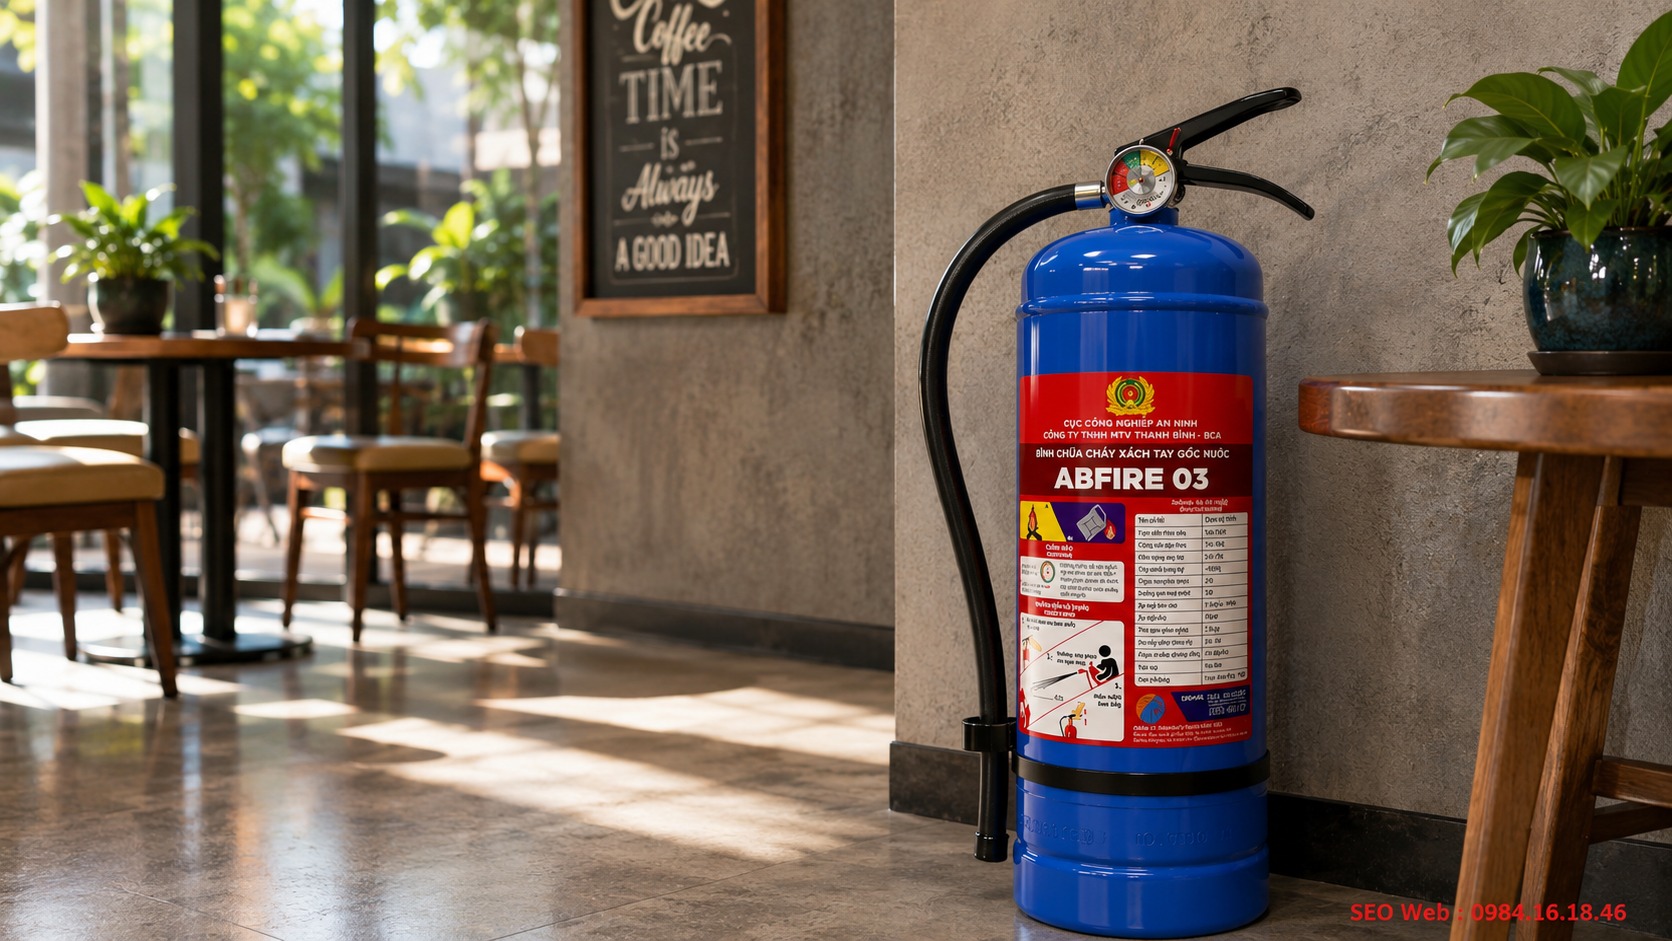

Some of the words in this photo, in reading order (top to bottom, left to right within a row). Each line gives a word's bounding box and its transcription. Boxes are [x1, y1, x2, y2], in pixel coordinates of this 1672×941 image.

[633, 0, 732, 65] Coffee
[618, 60, 722, 124] TIME
[660, 127, 679, 160] is
[621, 162, 719, 227] Always
[614, 237, 630, 272] A
[632, 234, 682, 271] GOOD
[685, 231, 730, 269] IDEA
[1067, 431, 1079, 439] TY
[1081, 431, 1108, 439] TNHH
[1110, 431, 1132, 439] MTV
[1134, 431, 1170, 439] THANH
[1203, 431, 1222, 440] BCA
[1156, 419, 1171, 428] AN
[1173, 419, 1198, 428] NINH
[1085, 445, 1116, 459] CHÁY
[1119, 445, 1151, 459] XÁCH
[1153, 449, 1175, 459] TAY
[1054, 467, 1164, 490] ABFIRE
[1172, 467, 1209, 490] 03
